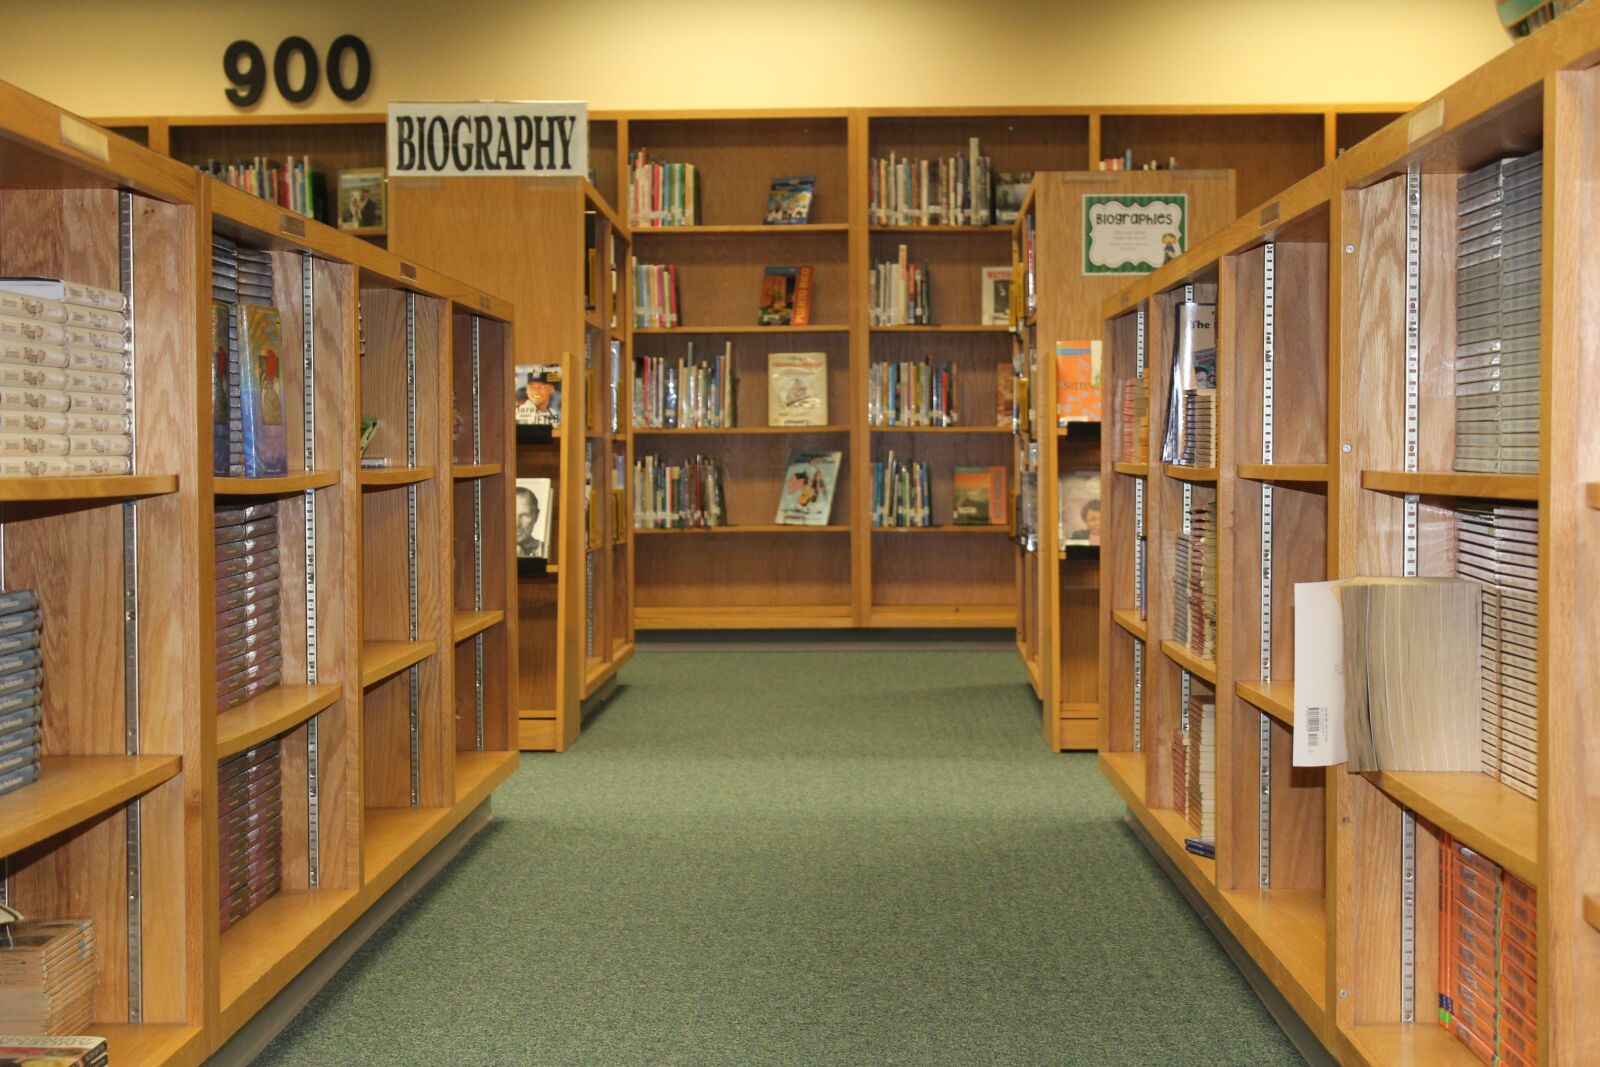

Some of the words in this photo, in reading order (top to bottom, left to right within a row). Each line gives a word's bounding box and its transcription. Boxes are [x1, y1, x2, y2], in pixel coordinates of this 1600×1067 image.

[223, 34, 371, 107] 900
[396, 114, 576, 171] BIOGRAPHY
[1096, 213, 1173, 225] Biographies
[1191, 320, 1210, 329] The
